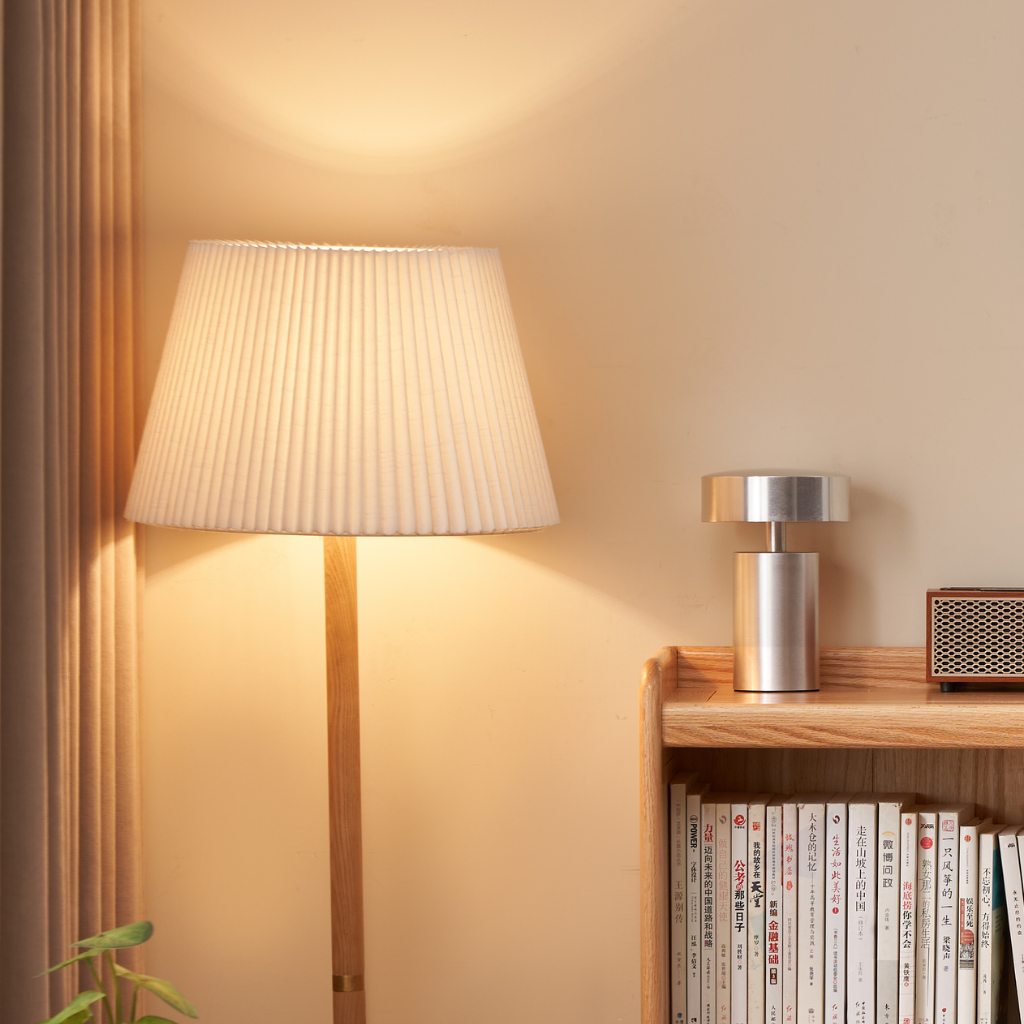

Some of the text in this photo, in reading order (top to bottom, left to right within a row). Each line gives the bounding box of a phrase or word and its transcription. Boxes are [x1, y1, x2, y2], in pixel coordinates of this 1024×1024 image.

[704, 824, 714, 843] 力量
[753, 841, 762, 879] 我的故乡在
[807, 813, 817, 872] 大木仓的记忆
[831, 834, 842, 905] 生活如此美好
[855, 825, 867, 912] 走在山坡上的中国
[882, 839, 894, 889] 微博问政
[941, 837, 956, 927] 一只风筝的一生
[704, 846, 714, 949] 迈向未来的中国道路和战略
[902, 881, 913, 949] 海底捞你学不会
[768, 920, 779, 965] 金融基础
[942, 936, 952, 961] 梁晓声
